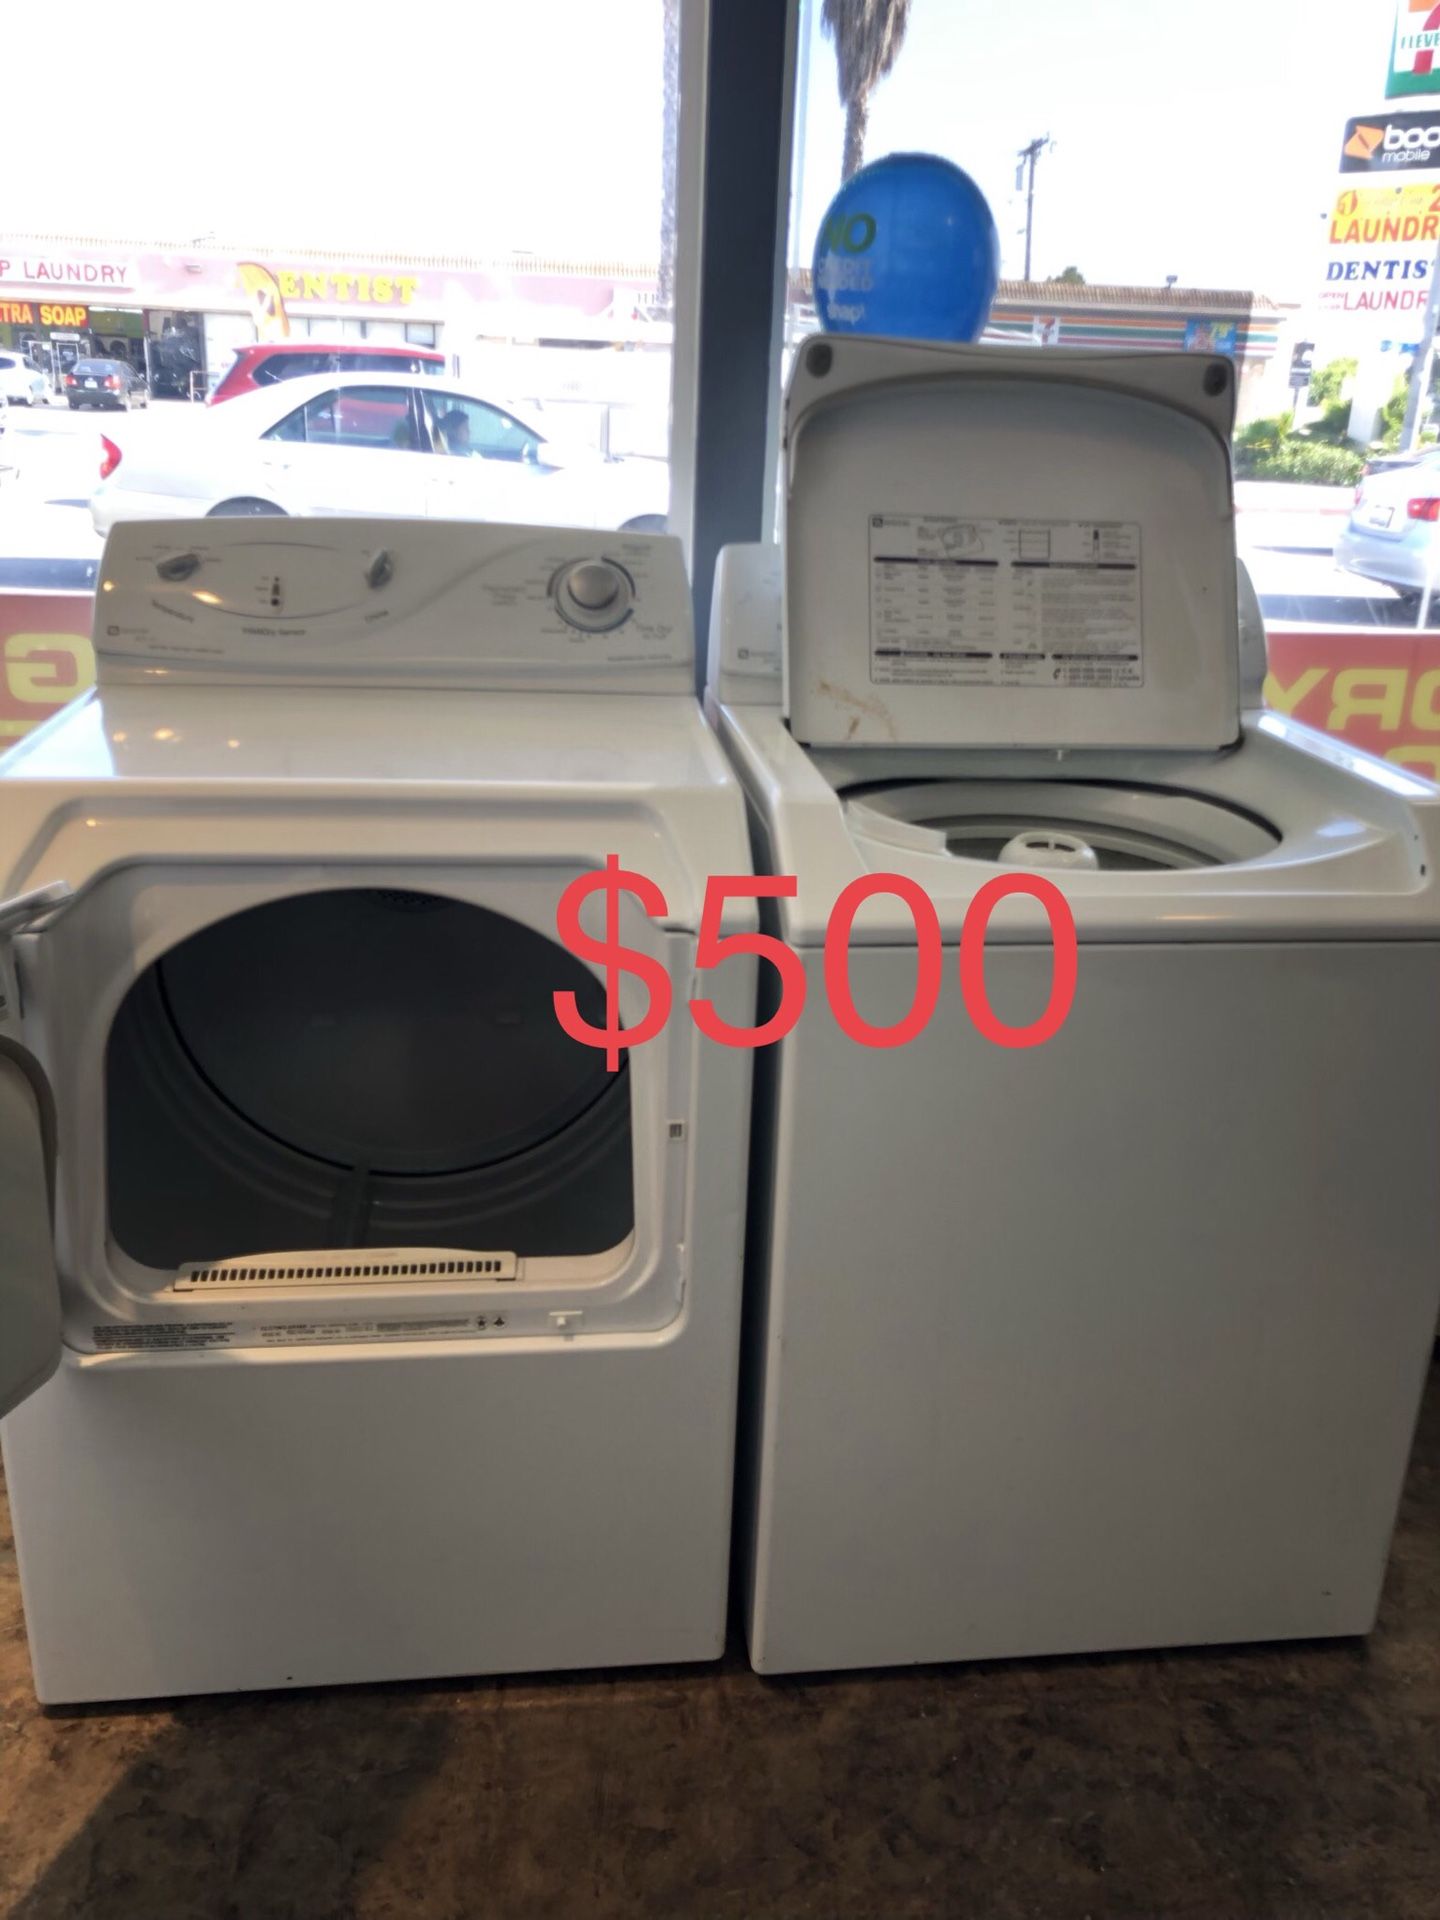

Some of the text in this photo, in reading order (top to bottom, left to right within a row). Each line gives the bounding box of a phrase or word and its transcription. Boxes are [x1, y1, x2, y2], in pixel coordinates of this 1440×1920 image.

[1382, 148, 1430, 163] mobile
[24, 261, 127, 283] LAUNDRY
[1326, 259, 1435, 280] DENTIS
[276, 271, 418, 305] ENTIST
[1343, 290, 1429, 310] LAUNDR
[0, 303, 87, 326] TRA SOAP
